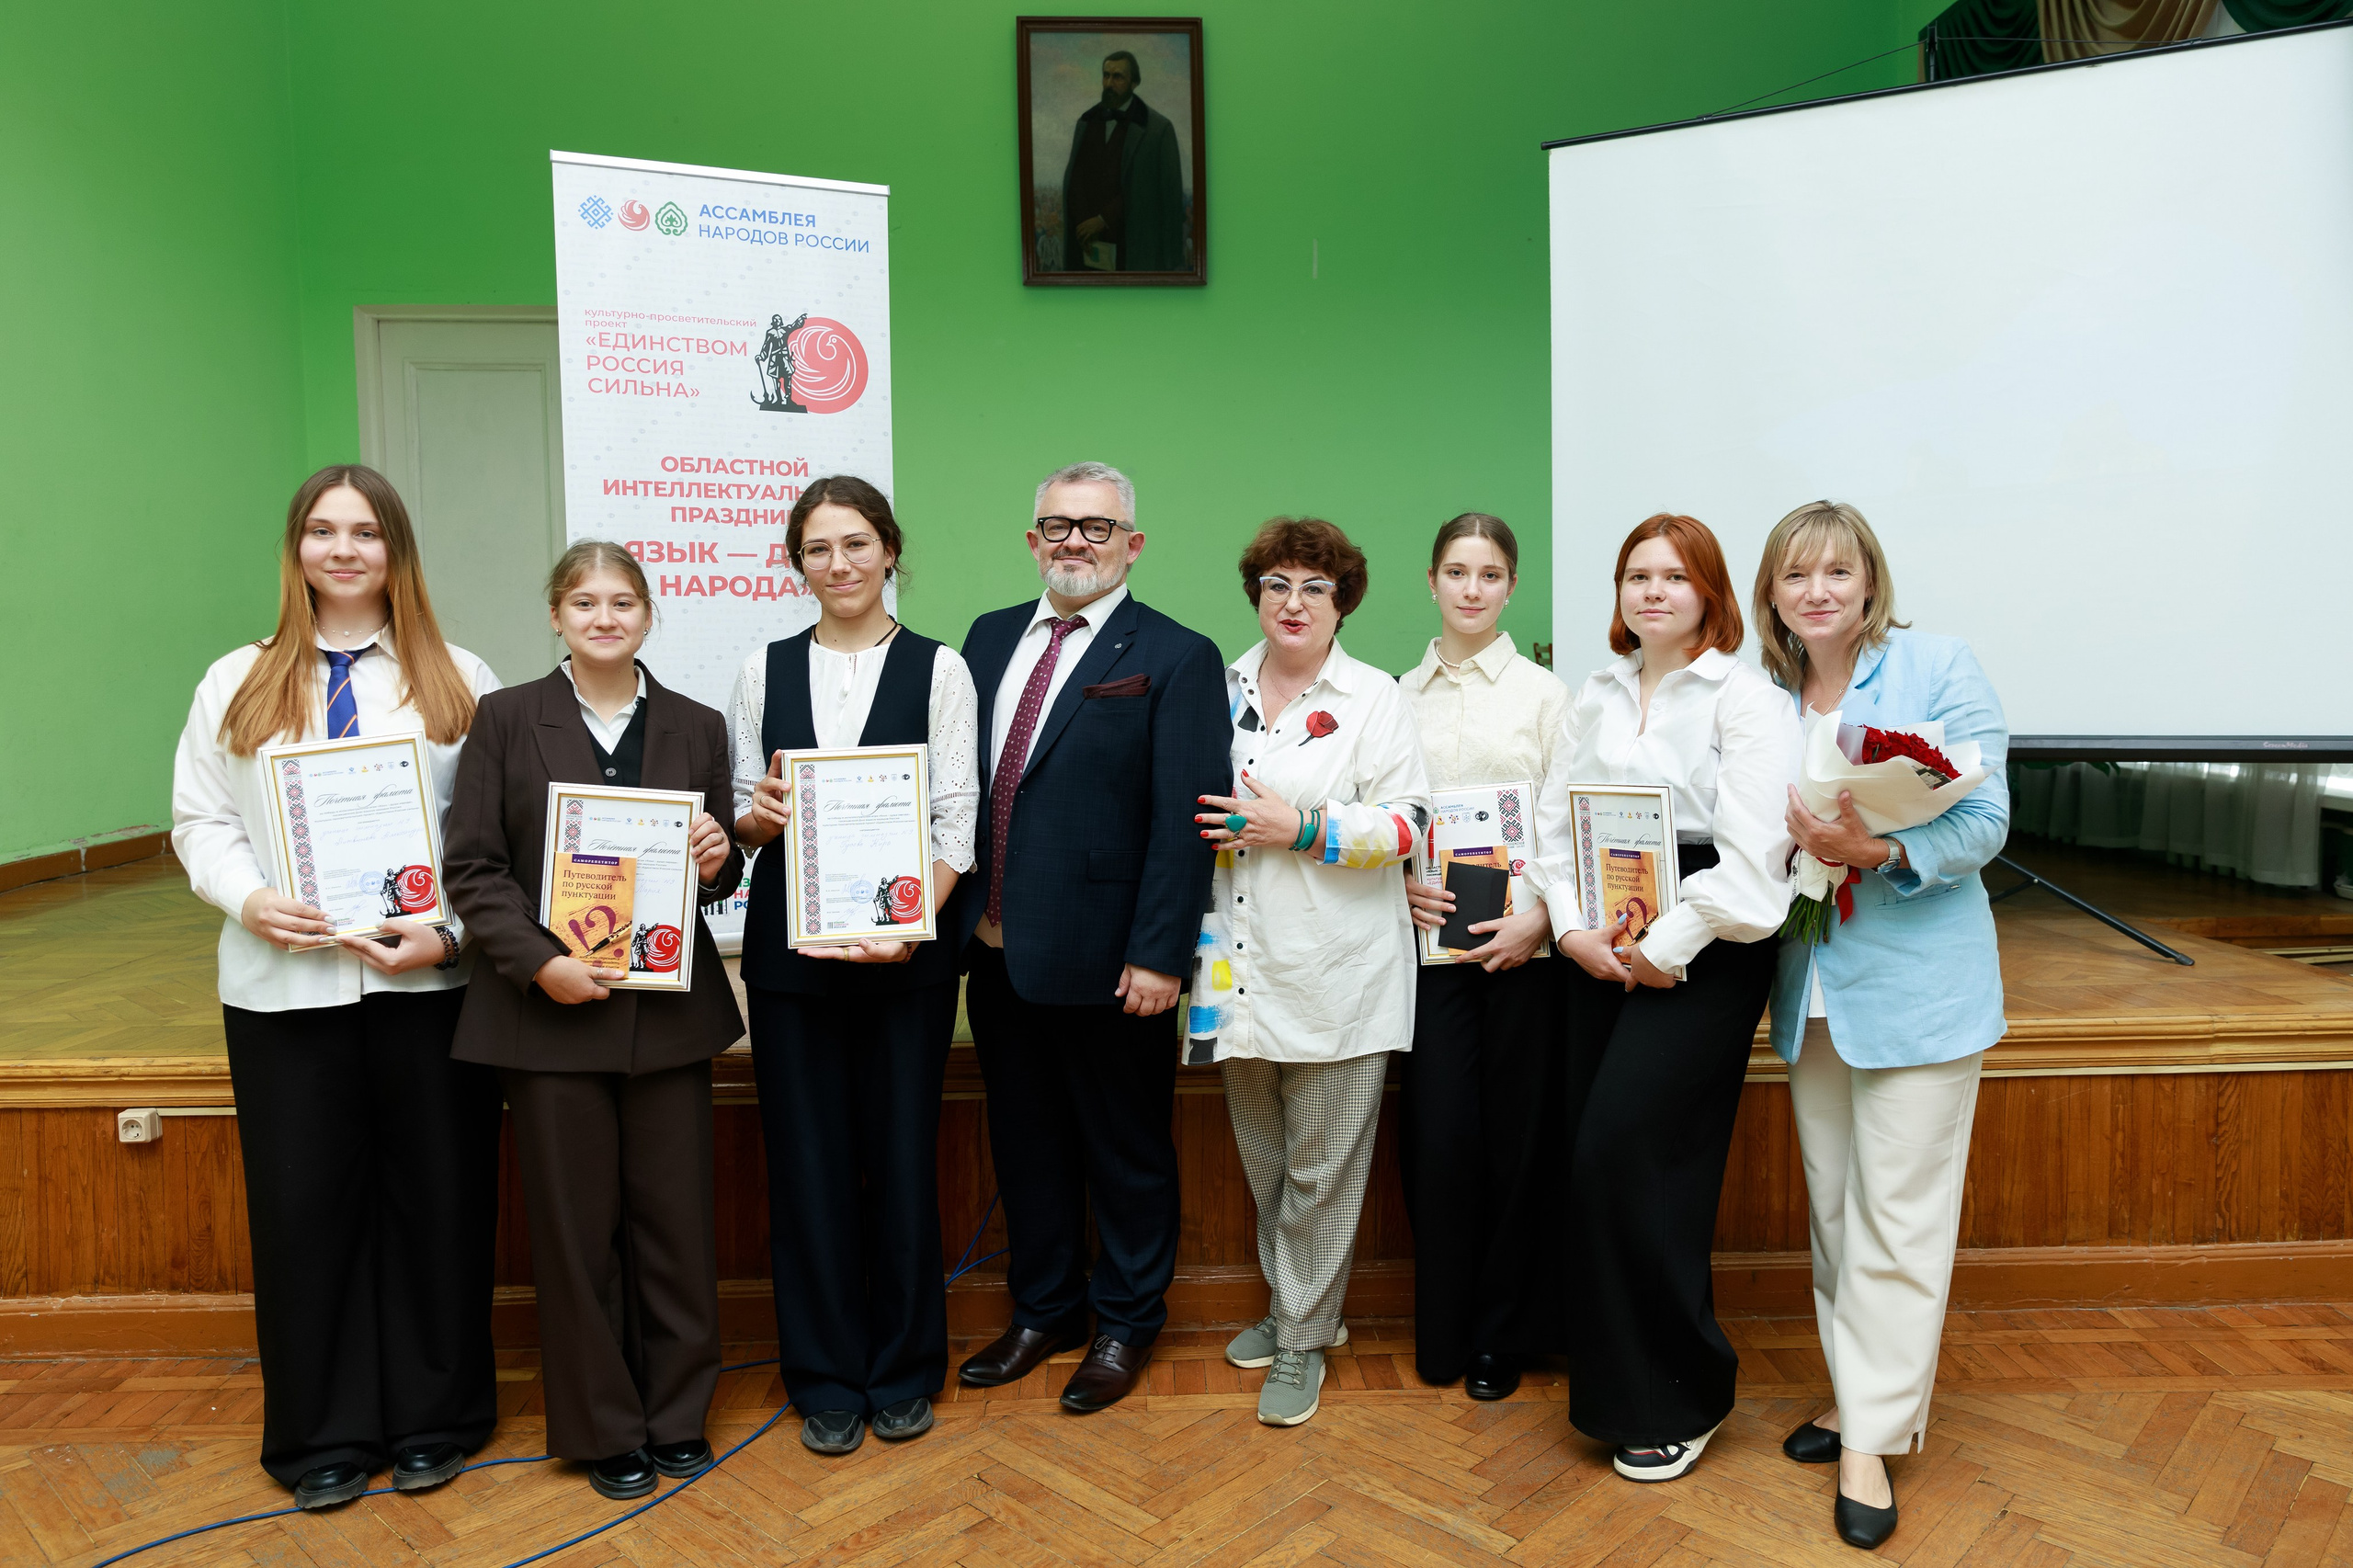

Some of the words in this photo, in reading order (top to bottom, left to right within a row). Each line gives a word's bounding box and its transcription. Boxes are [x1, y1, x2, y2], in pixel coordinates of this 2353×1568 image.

[699, 204, 816, 228] АССАМБЛЕЯ
[699, 224, 789, 246] НАРОДОВ
[794, 234, 870, 253] РОССИИ
[585, 309, 757, 327] культурно-просветительский
[585, 321, 628, 331] проект
[586, 332, 748, 358] «ЕДИНСТВОМ
[586, 356, 684, 376] РОССИЯ
[588, 379, 700, 399] СИЛЬНА»
[661, 456, 809, 477] ОБЛАСТНОЙ
[603, 480, 805, 501] ИНТЕЛЛЕКТУАЛЬ
[671, 506, 791, 527] ПРАЗДНИ
[563, 869, 627, 882] Путеводитель
[1606, 863, 1649, 874] Путеводитель
[575, 882, 612, 891] русской
[1607, 882, 1644, 892] пунктуации
[1615, 875, 1640, 883] русской
[562, 890, 616, 901] пунктуации
